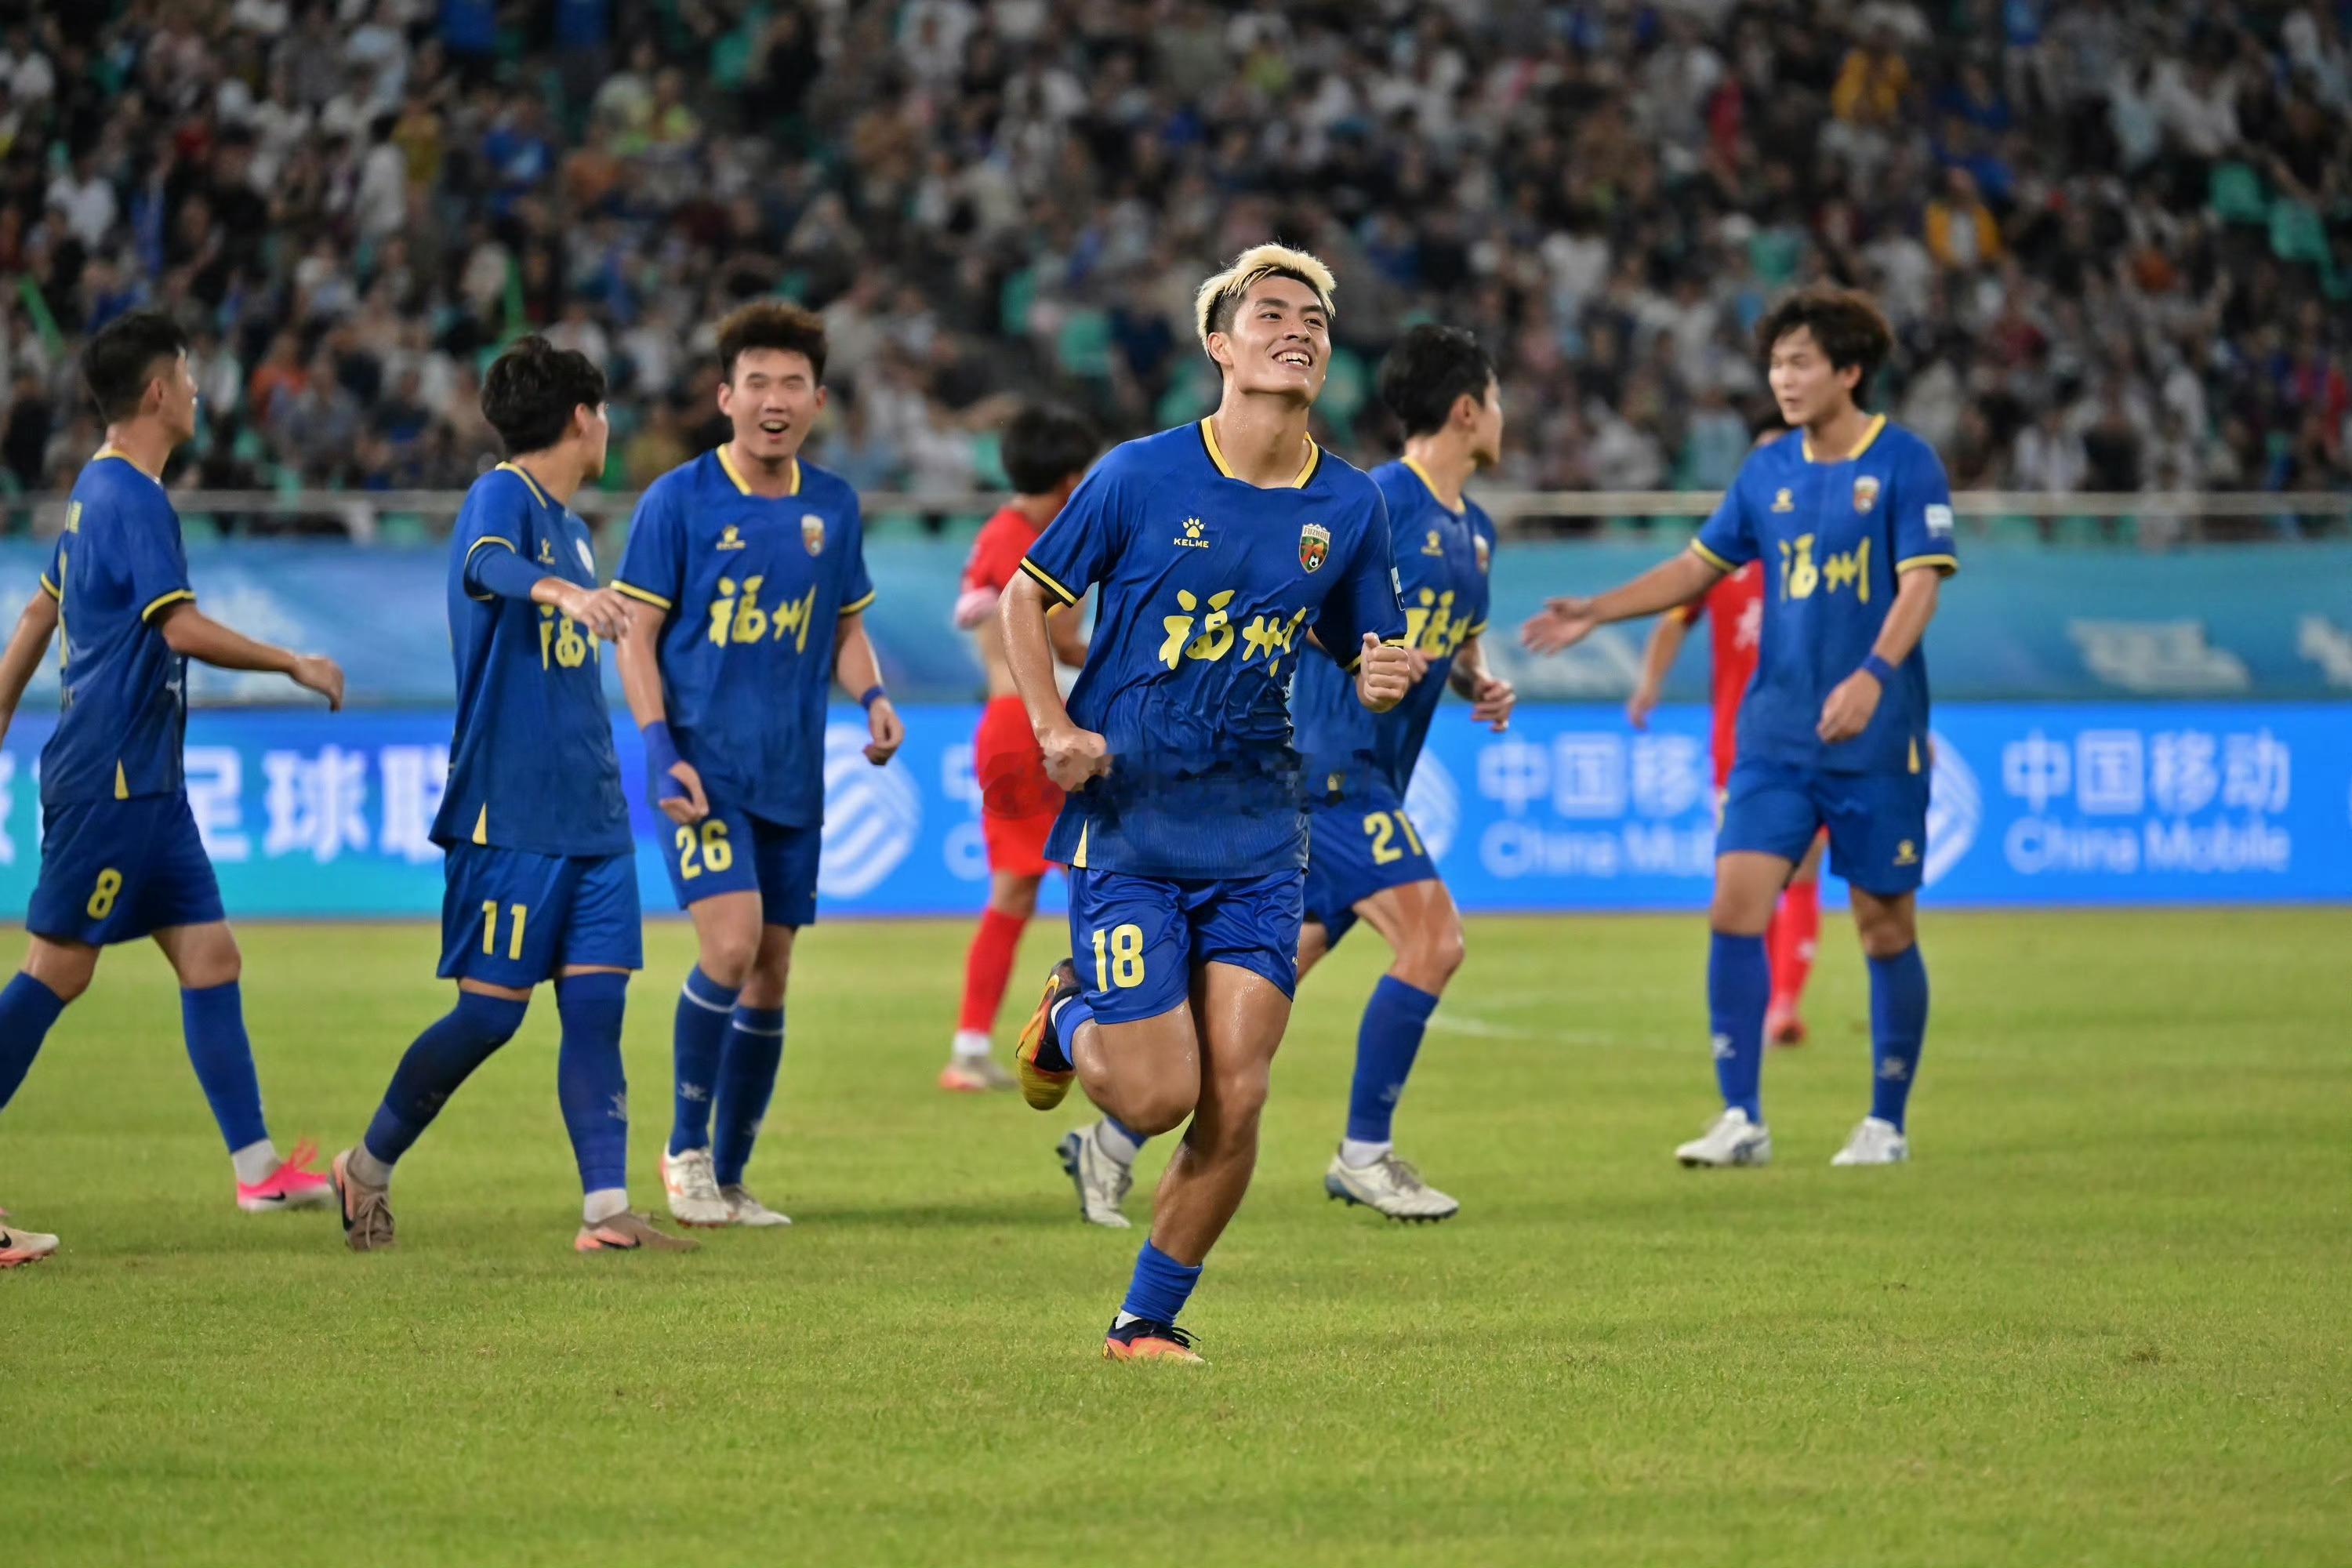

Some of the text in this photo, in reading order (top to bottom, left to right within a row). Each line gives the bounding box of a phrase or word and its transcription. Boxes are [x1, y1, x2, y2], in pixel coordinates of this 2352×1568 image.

[1174, 538, 1209, 548] KELME
[709, 575, 817, 653] 福州
[1159, 589, 1307, 677] 福州
[1476, 732, 1712, 818] 中国移
[2002, 728, 2291, 816] 中国移动
[676, 819, 732, 880] 26
[1363, 809, 1423, 865] 21
[2004, 815, 2292, 874] China Mobile
[87, 868, 122, 920] 8
[481, 900, 528, 960] 11
[1091, 924, 1145, 993] 18
